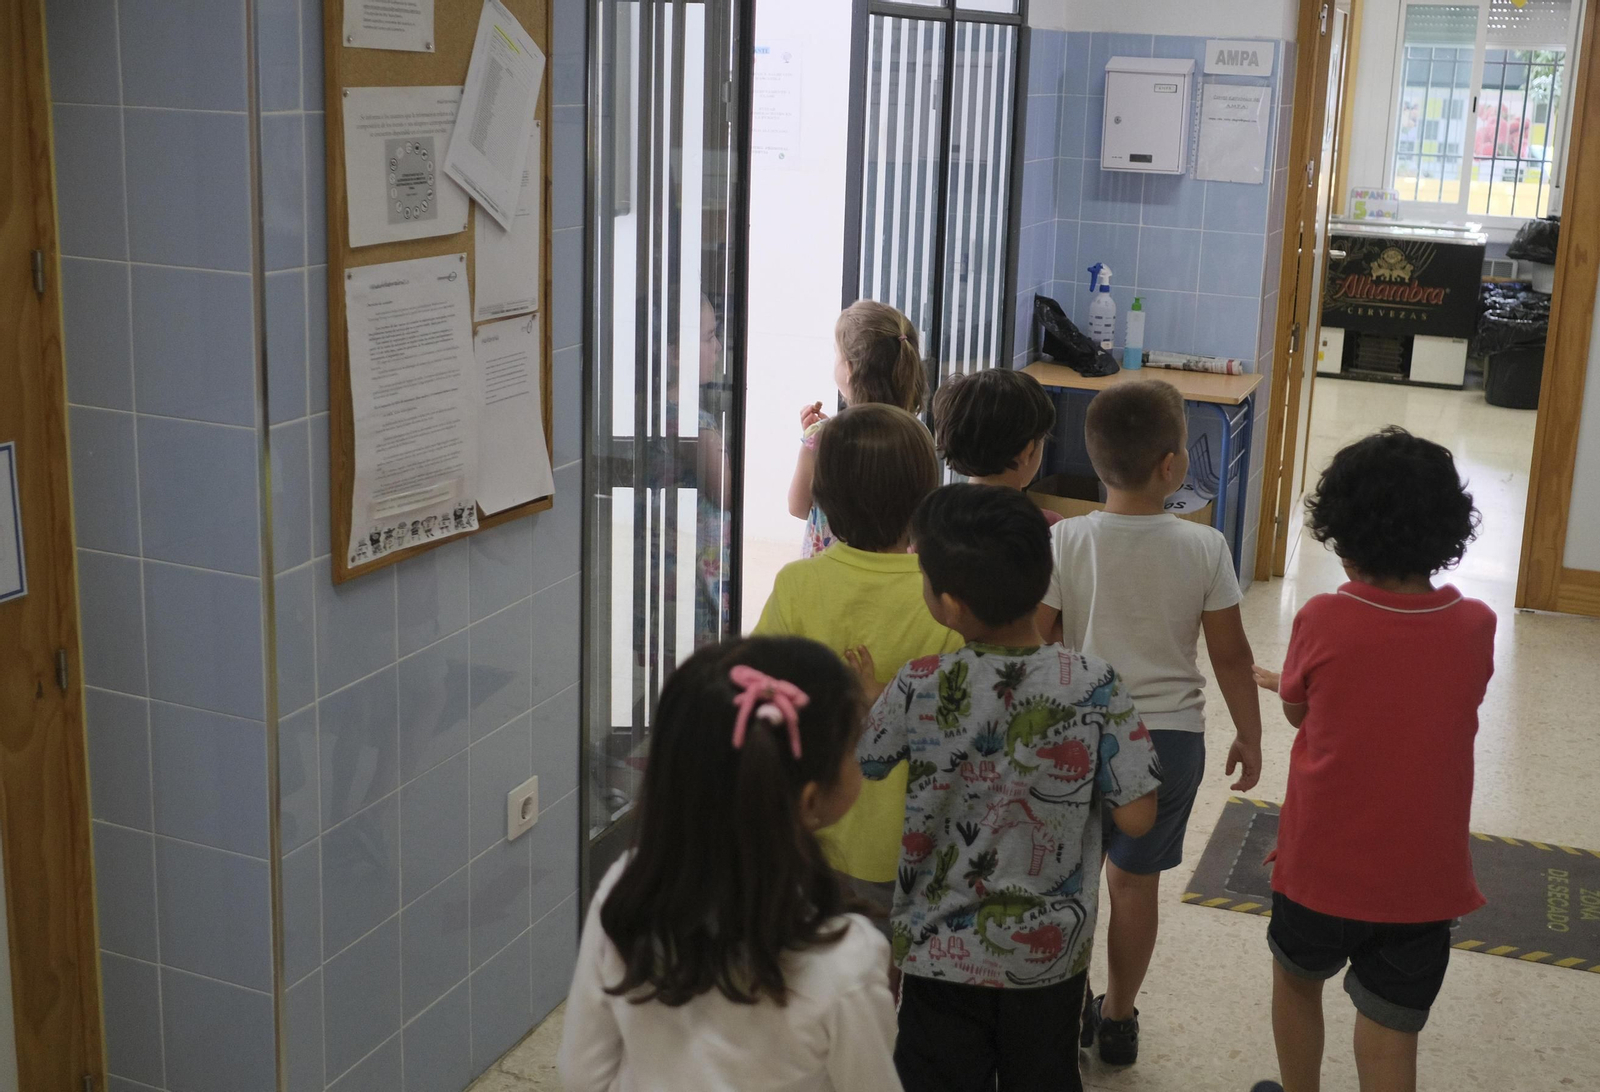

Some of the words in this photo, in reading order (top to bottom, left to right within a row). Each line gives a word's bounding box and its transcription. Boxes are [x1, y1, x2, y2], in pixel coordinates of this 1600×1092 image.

[1215, 50, 1259, 67] AMPA
[1353, 201, 1367, 220] 5
[1334, 273, 1445, 305] Alhambra
[1347, 307, 1428, 321] CERVEZAS
[1547, 868, 1570, 932] DESECADO
